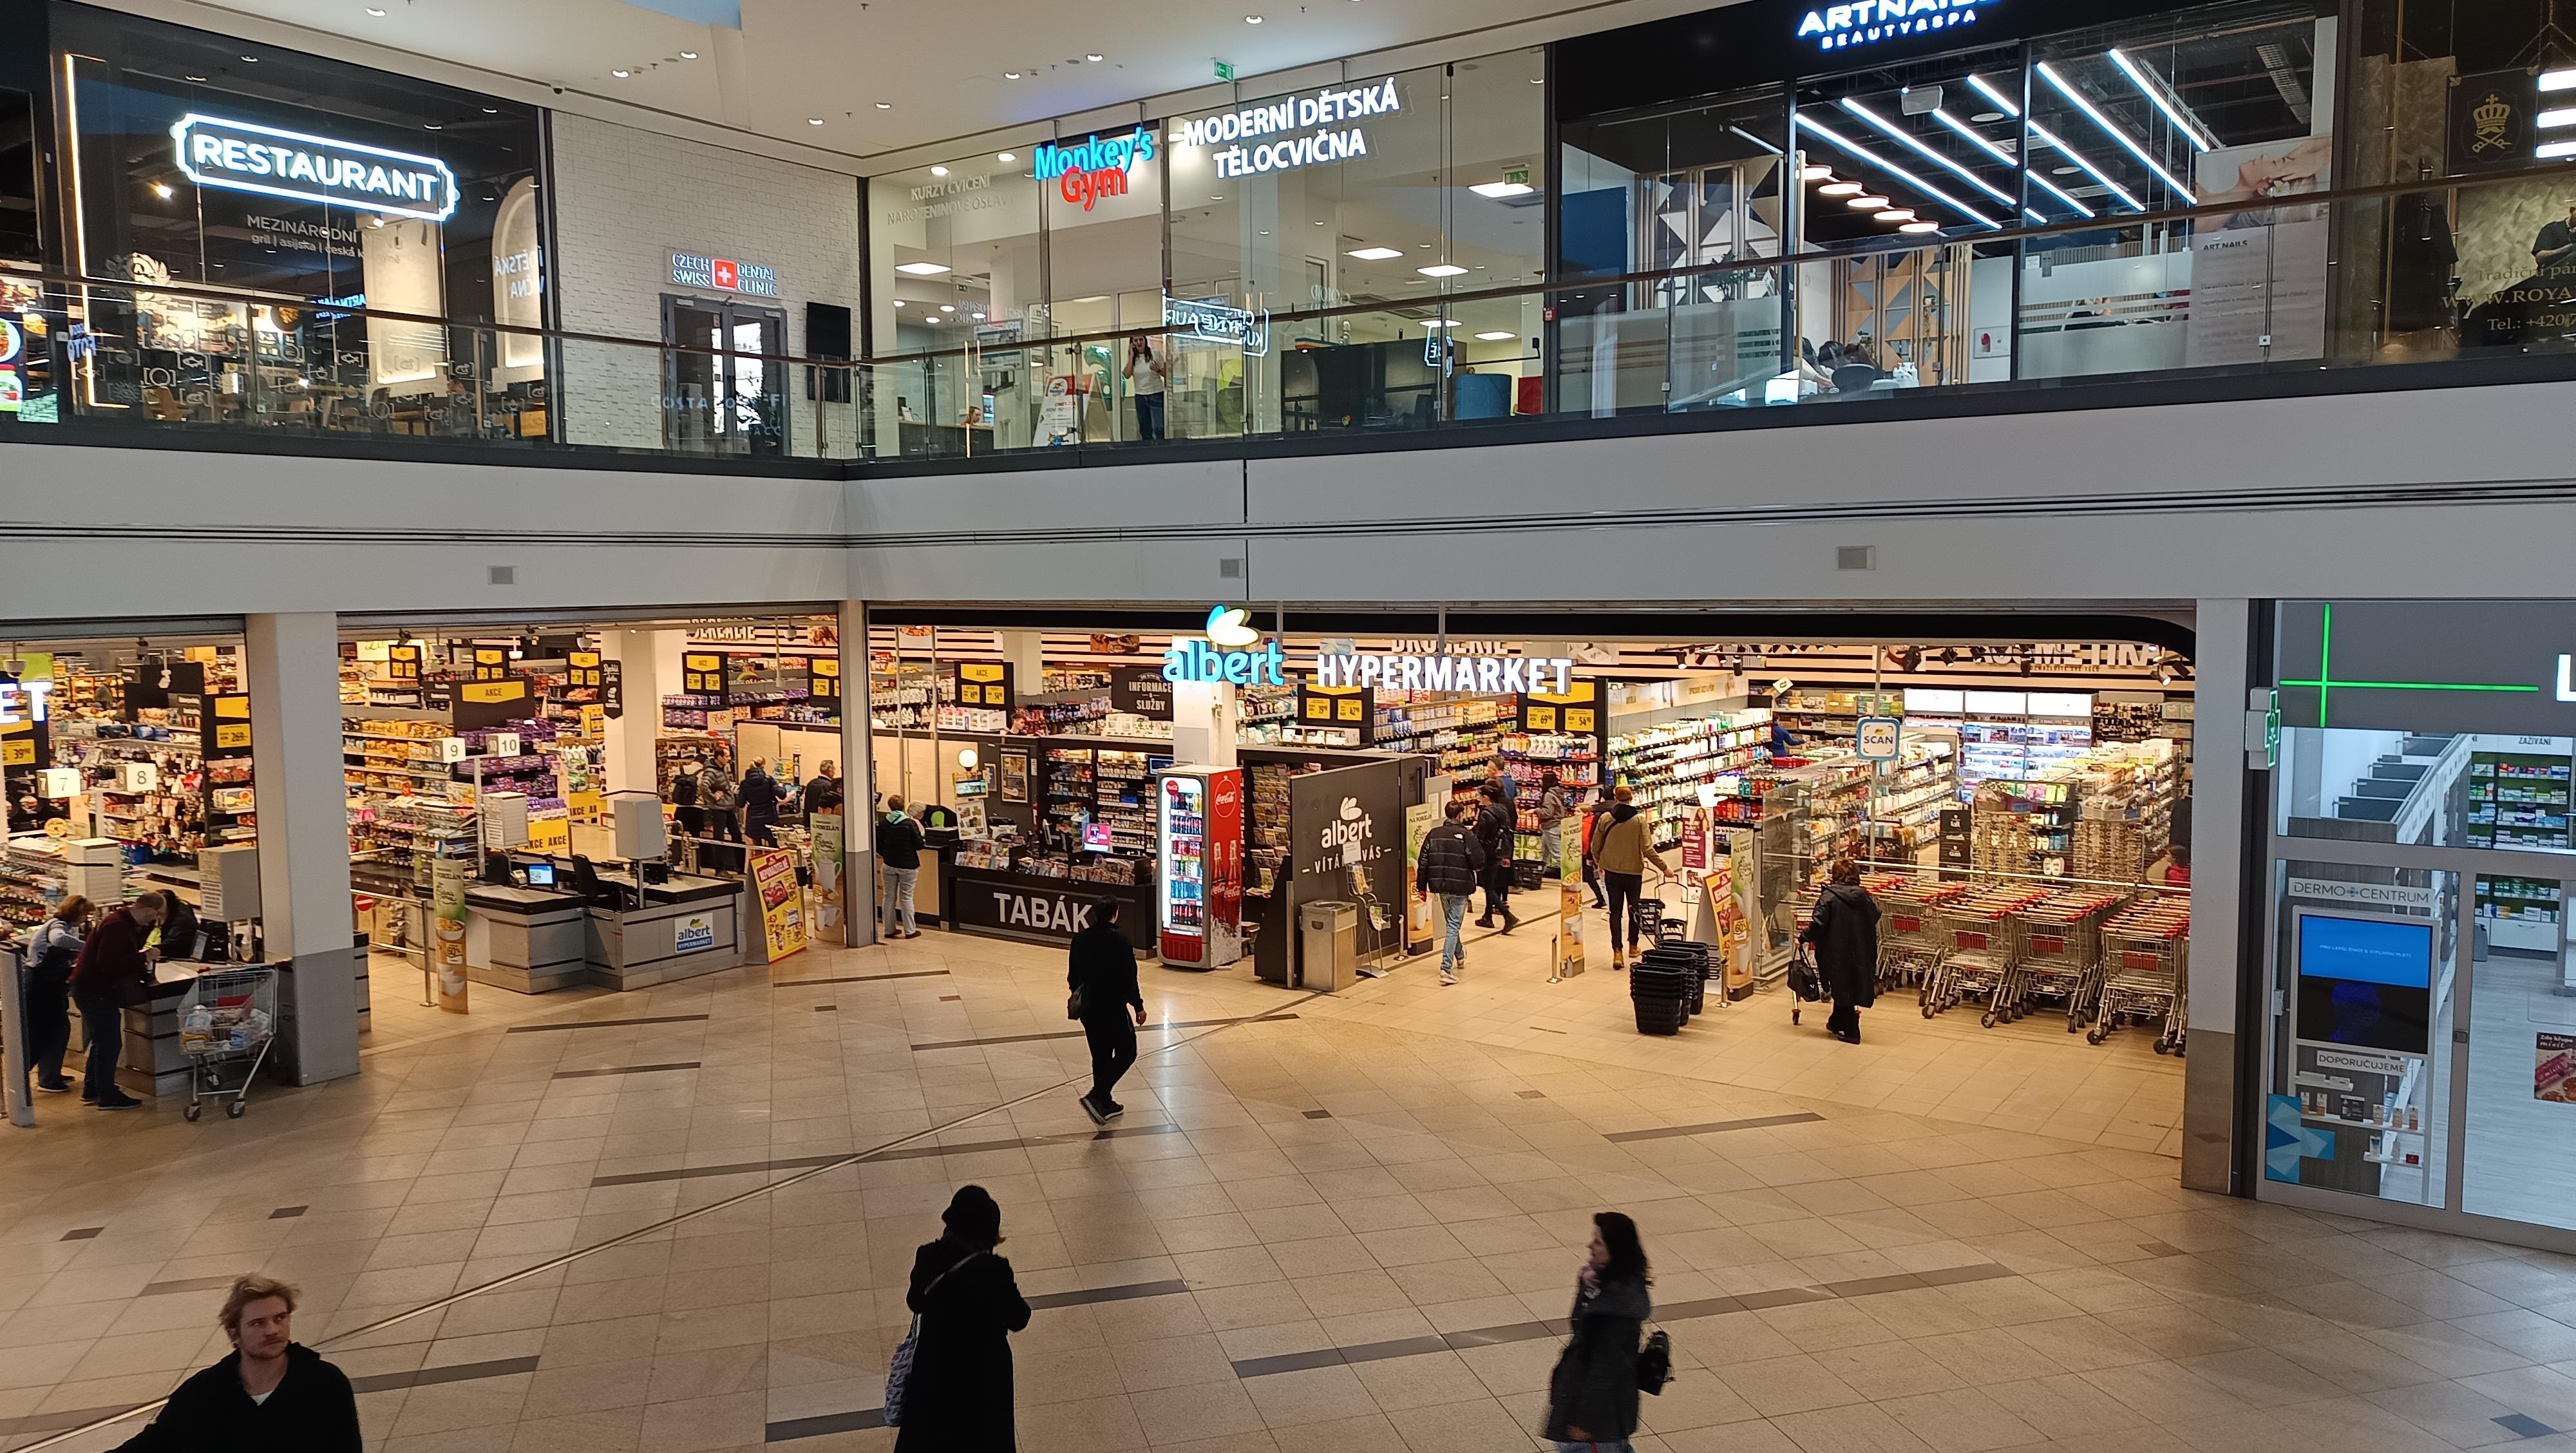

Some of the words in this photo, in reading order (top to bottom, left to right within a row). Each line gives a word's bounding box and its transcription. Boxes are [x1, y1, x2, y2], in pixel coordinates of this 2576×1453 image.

[1798, 0, 2002, 36] ARTNA
[1822, 9, 1976, 49] BEAUTY&SPA
[1184, 97, 1295, 147] MODERNÍ
[1300, 77, 1399, 127] DĚTSKÁ
[1035, 126, 1153, 180] Monkey's
[1213, 129, 1367, 178] TĚLOCVIČNA
[194, 134, 439, 202] RESTAURANT
[911, 184, 945, 202] KURZY
[1061, 166, 1127, 211] Gym
[247, 214, 358, 243] MEZINÁRODNÍ
[2222, 240, 2248, 249] NAILS
[672, 252, 710, 272] CZECH
[673, 269, 710, 287] SWISS
[737, 263, 777, 281] DENTAL
[737, 279, 777, 296] CLINIC
[1162, 640, 1285, 686] albert
[1318, 654, 1573, 694] HYPERMARKET
[1129, 681, 1173, 693] INFORMACE
[1136, 699, 1166, 710] SLUŽBY
[501, 739, 517, 752] 10
[1864, 736, 1893, 744] SCAN
[450, 745, 459, 757] 9
[59, 777, 68, 791] 7
[137, 770, 147, 784] 8
[1321, 813, 1372, 848] albert
[548, 835, 567, 846] AKCE
[1362, 845, 1381, 862] VÁS
[2293, 882, 2346, 897] DERMO
[2360, 888, 2429, 903] CENTRUM
[993, 892, 1093, 933] TABÁK
[678, 925, 710, 940] albert
[2319, 1054, 2405, 1074] DOPORUČUJEME
